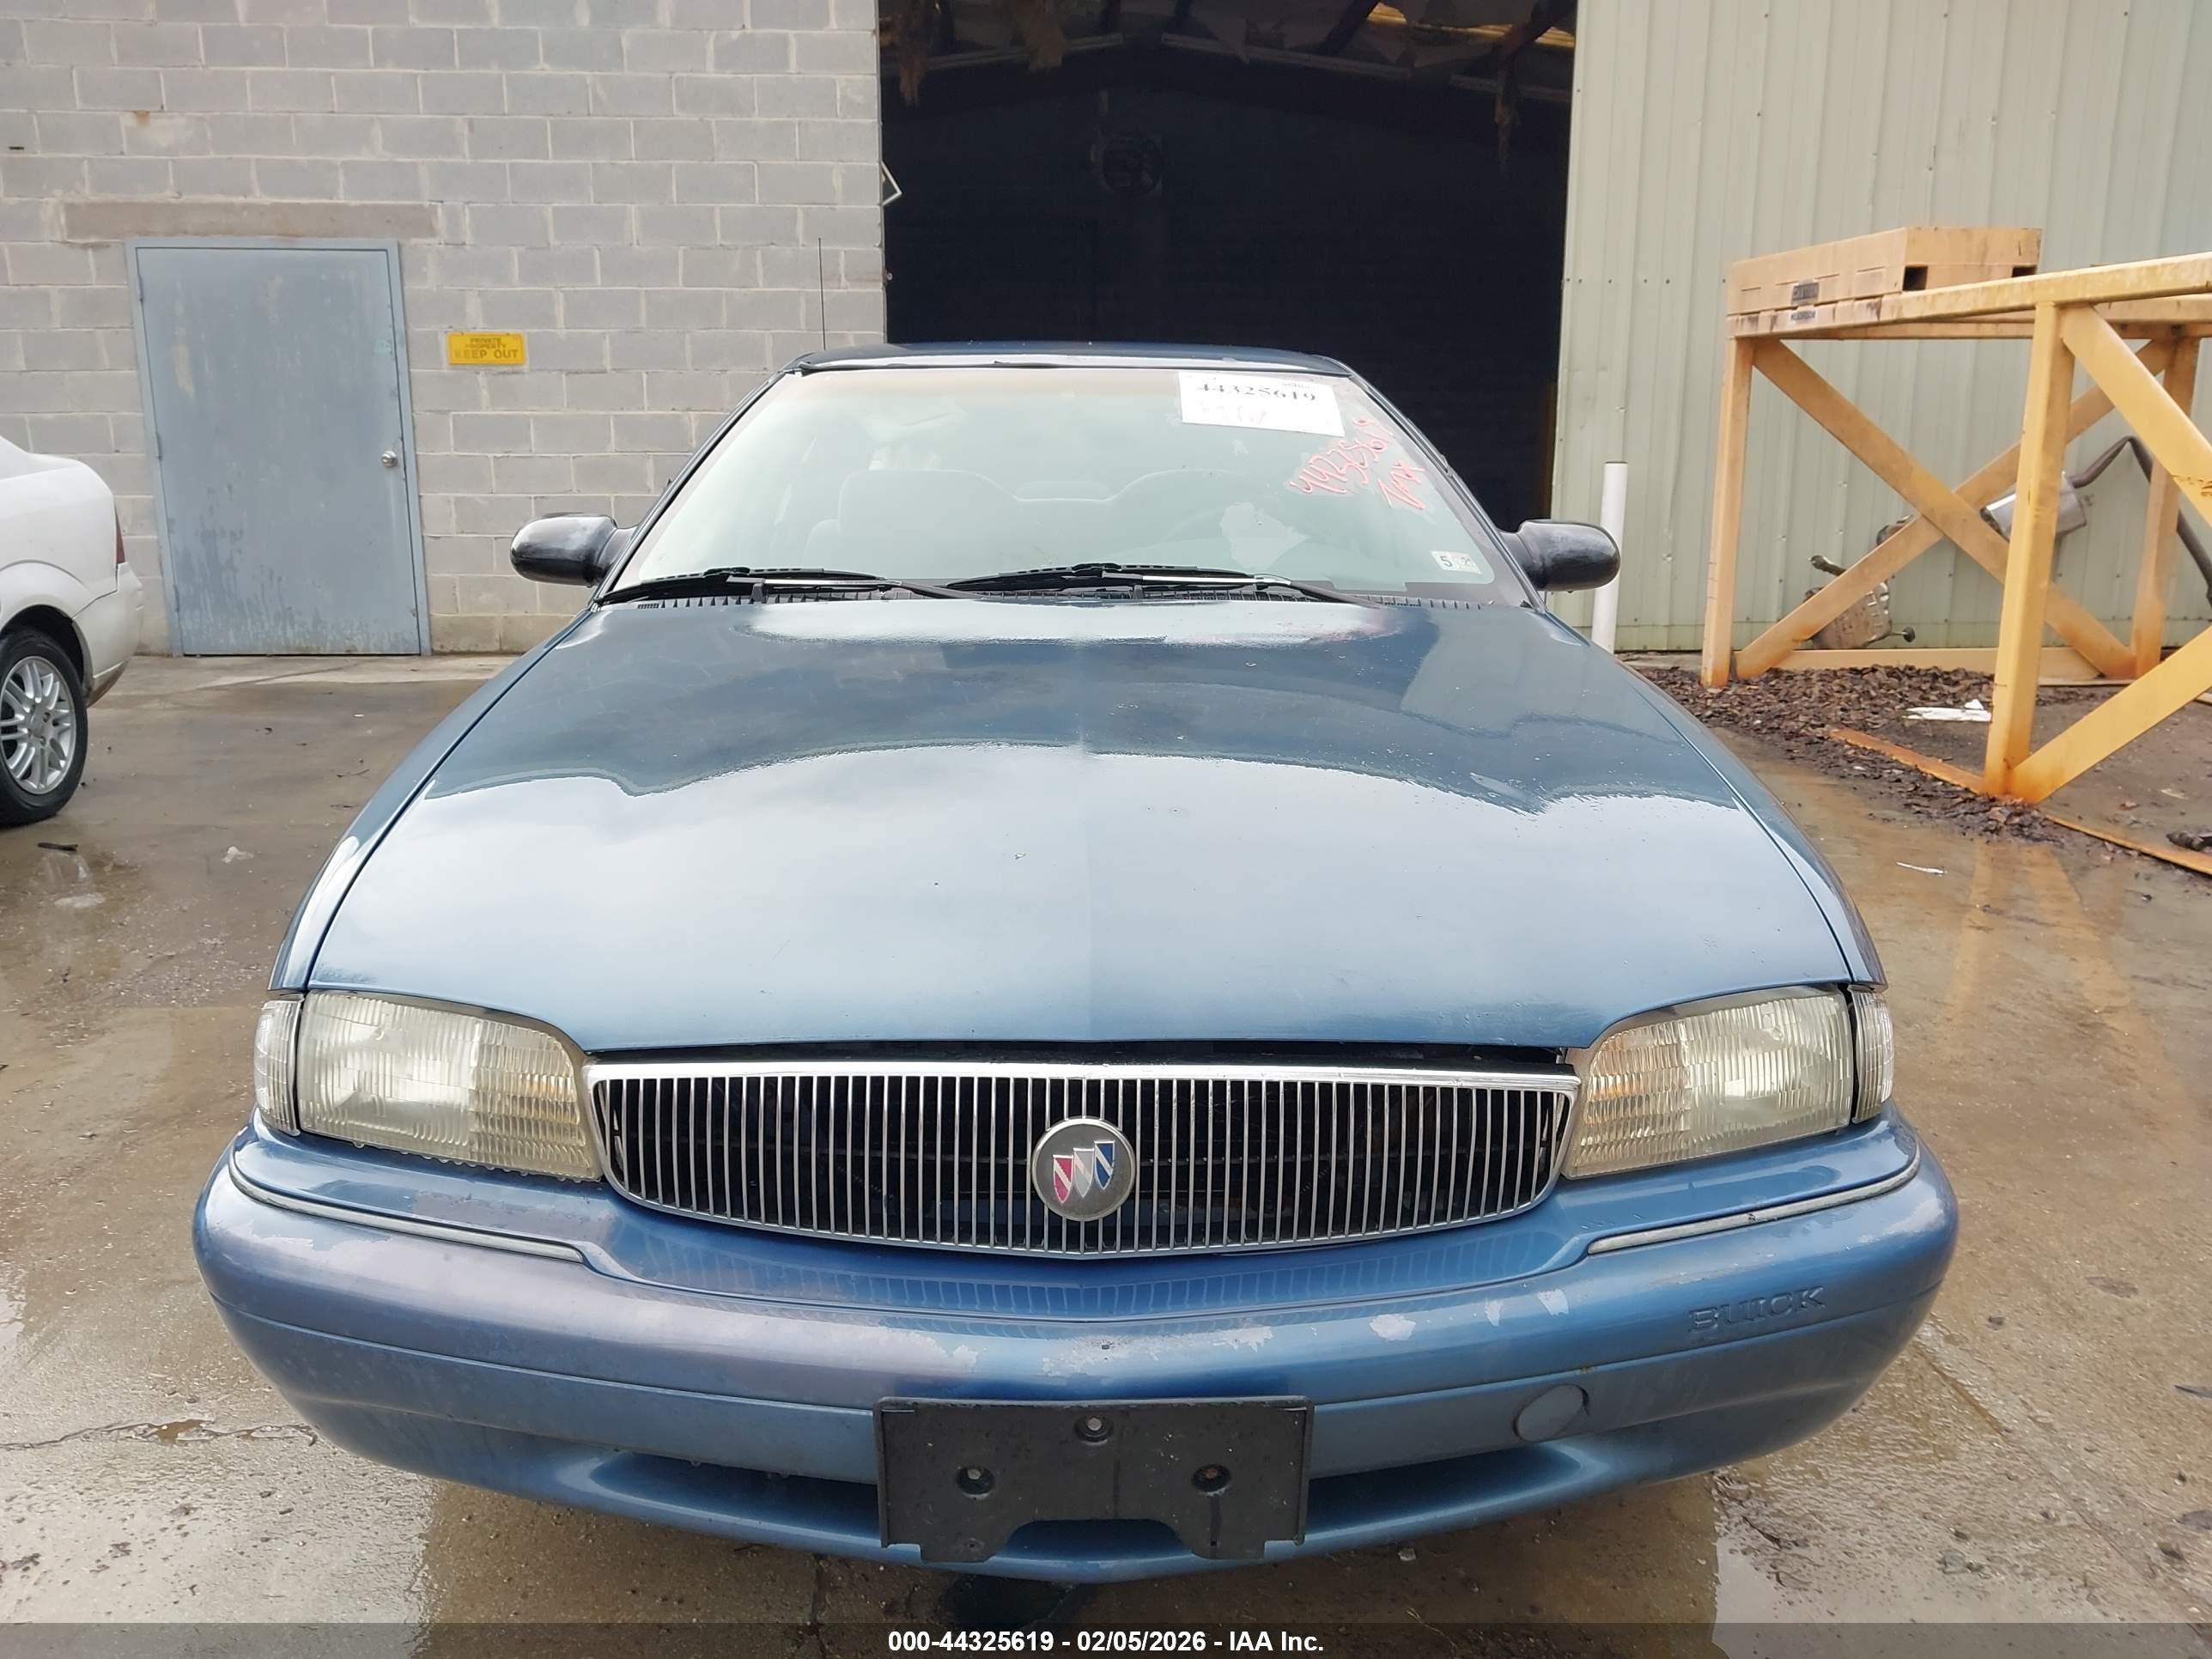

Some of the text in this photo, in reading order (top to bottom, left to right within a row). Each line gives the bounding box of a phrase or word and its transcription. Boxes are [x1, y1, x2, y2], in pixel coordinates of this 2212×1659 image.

[454, 349, 518, 359] KEEP OUT
[1440, 556, 1453, 568] 5
[1689, 1285, 1826, 1333] BUICK
